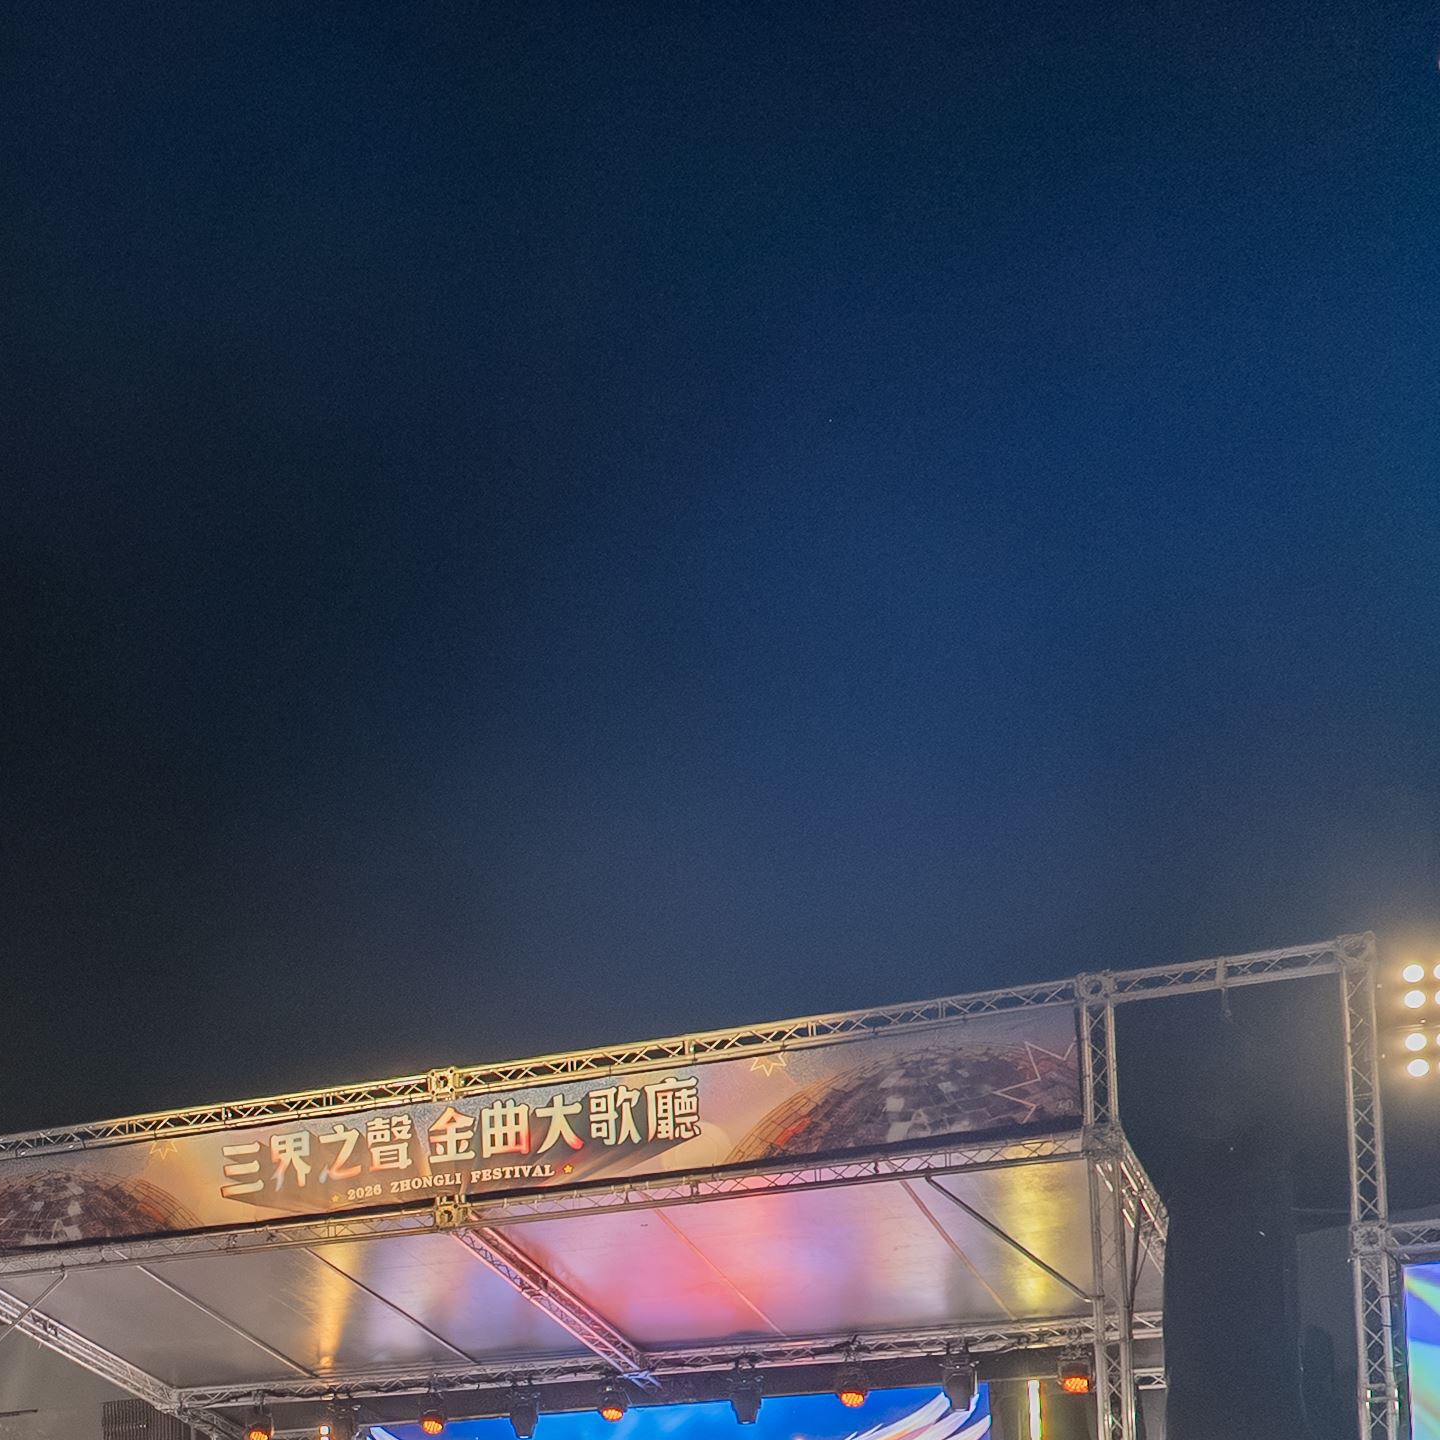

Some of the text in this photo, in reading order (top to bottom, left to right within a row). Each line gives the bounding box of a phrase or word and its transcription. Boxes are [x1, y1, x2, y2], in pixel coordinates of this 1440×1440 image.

[221, 1075, 702, 1197] 三界之聲 金曲大歌廳
[347, 1164, 555, 1200] 2026 ZHONGLI FESTIVAL
